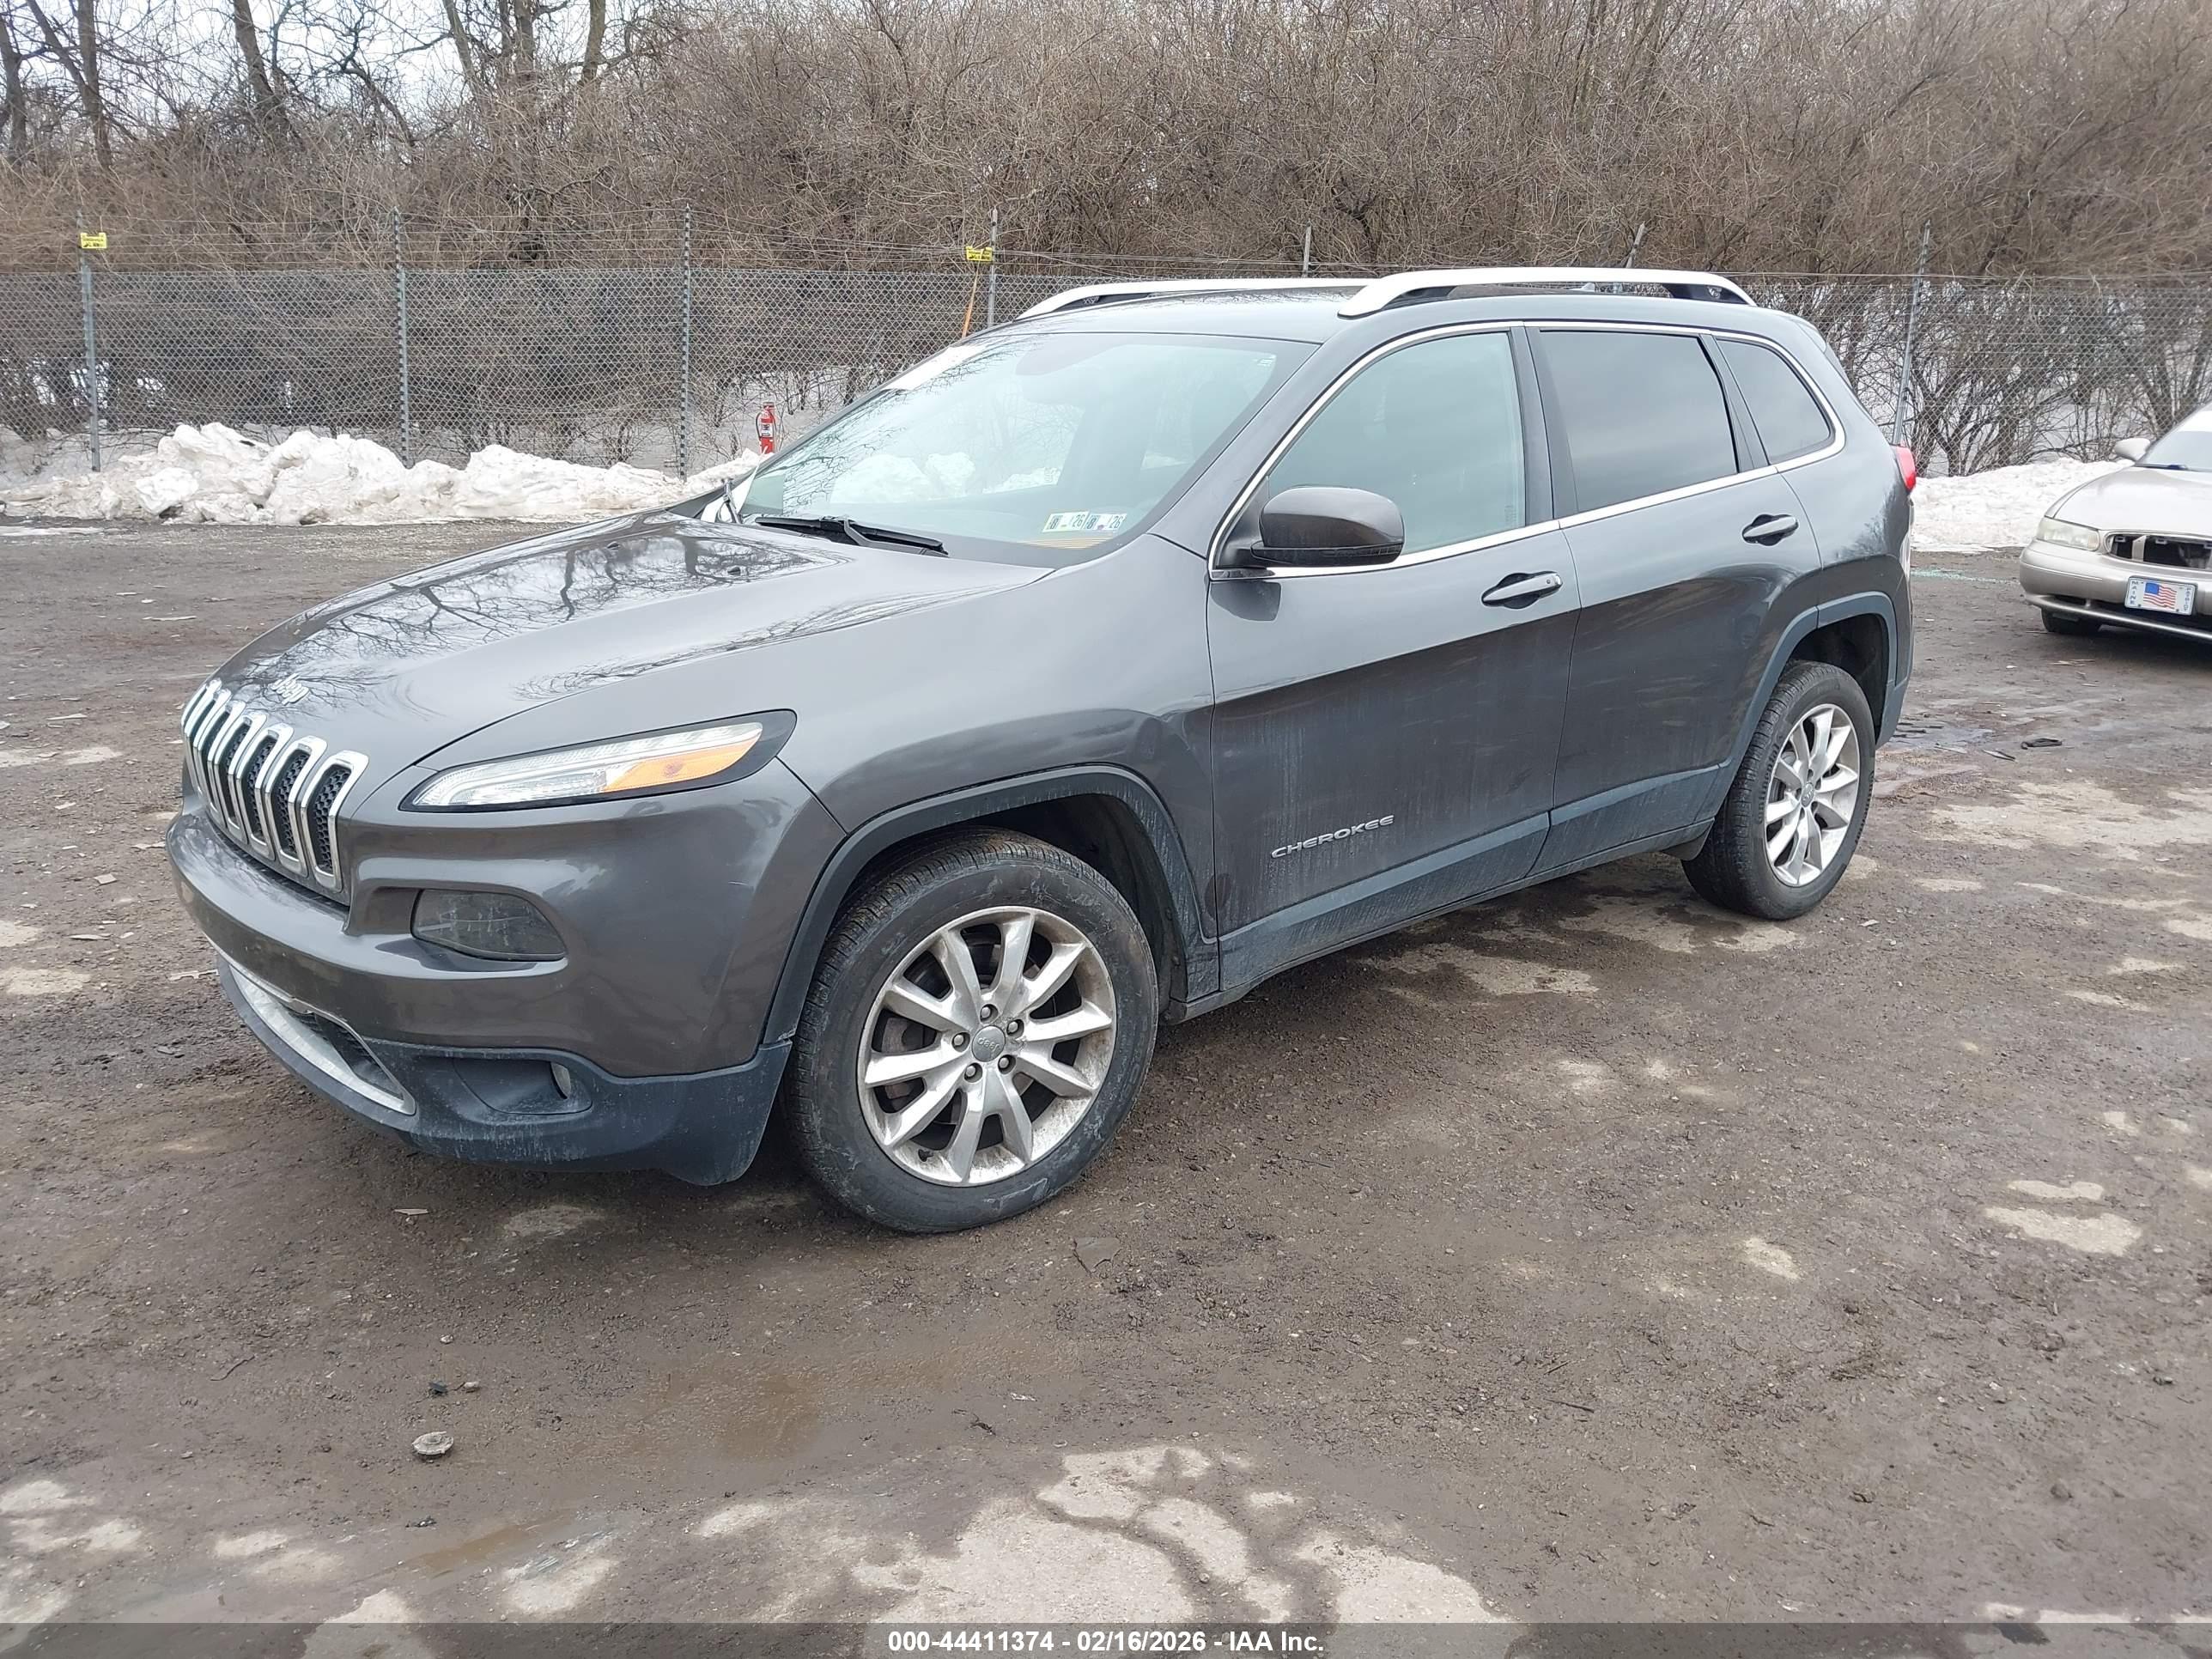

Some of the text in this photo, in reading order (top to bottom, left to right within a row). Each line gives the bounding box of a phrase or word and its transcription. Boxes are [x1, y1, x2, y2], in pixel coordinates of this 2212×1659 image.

[1072, 514, 1085, 528] 26
[1109, 515, 1123, 529] 26
[2130, 580, 2139, 605] MAINE
[267, 672, 310, 706] Jeep
[1271, 815, 1395, 859] CHEROKEE
